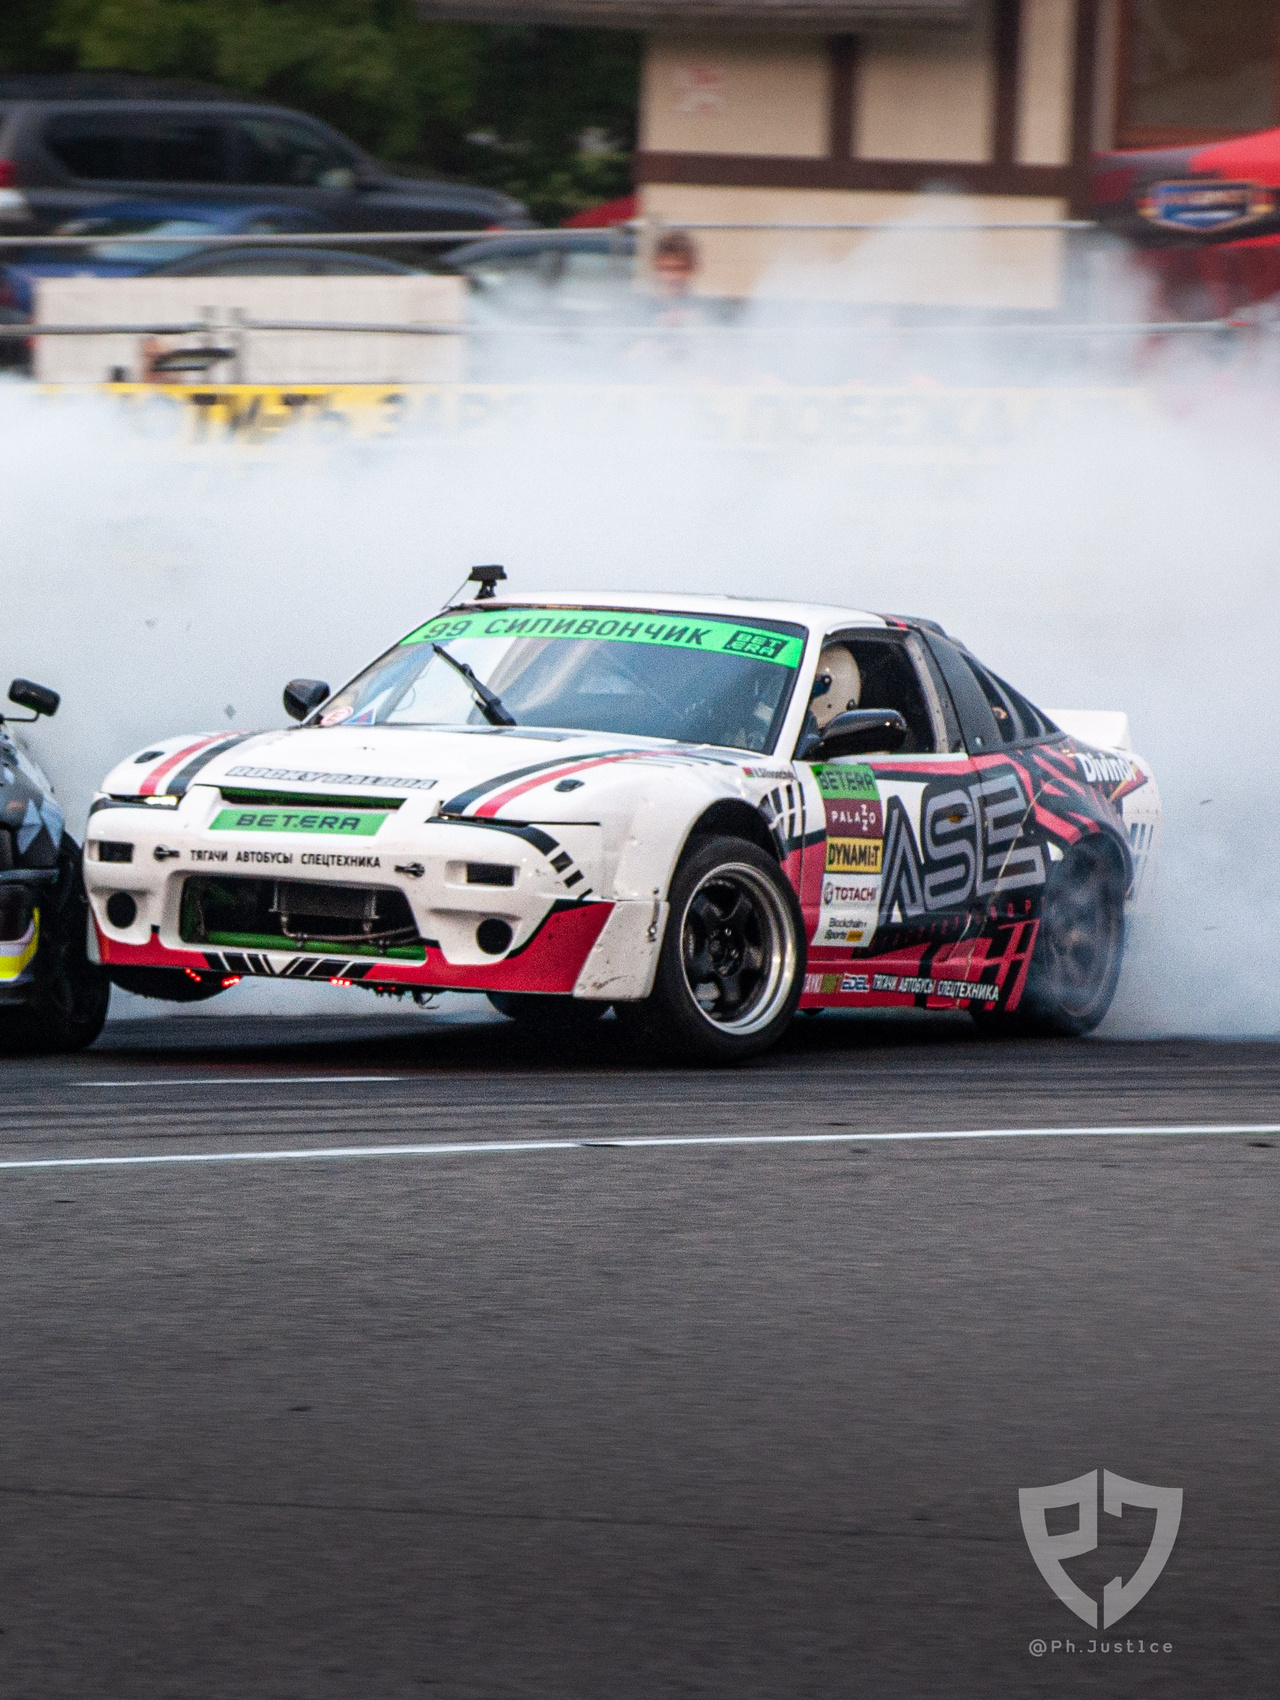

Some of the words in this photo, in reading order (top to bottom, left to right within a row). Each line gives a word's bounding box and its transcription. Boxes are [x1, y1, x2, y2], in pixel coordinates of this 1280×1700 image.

[423, 619, 474, 640] 99
[483, 616, 712, 646] СИЛИВОНЧИК
[190, 849, 228, 862] ТЯГАЧИ
[235, 851, 293, 865] АВТОБУСЫ
[300, 852, 381, 868] СПЕЦТЕХНИКА
[835, 886, 878, 901] TOTACHI
[898, 976, 936, 995] АВТОБУСЫ
[937, 979, 1000, 1001] СПЕЦТЕХНИКА
